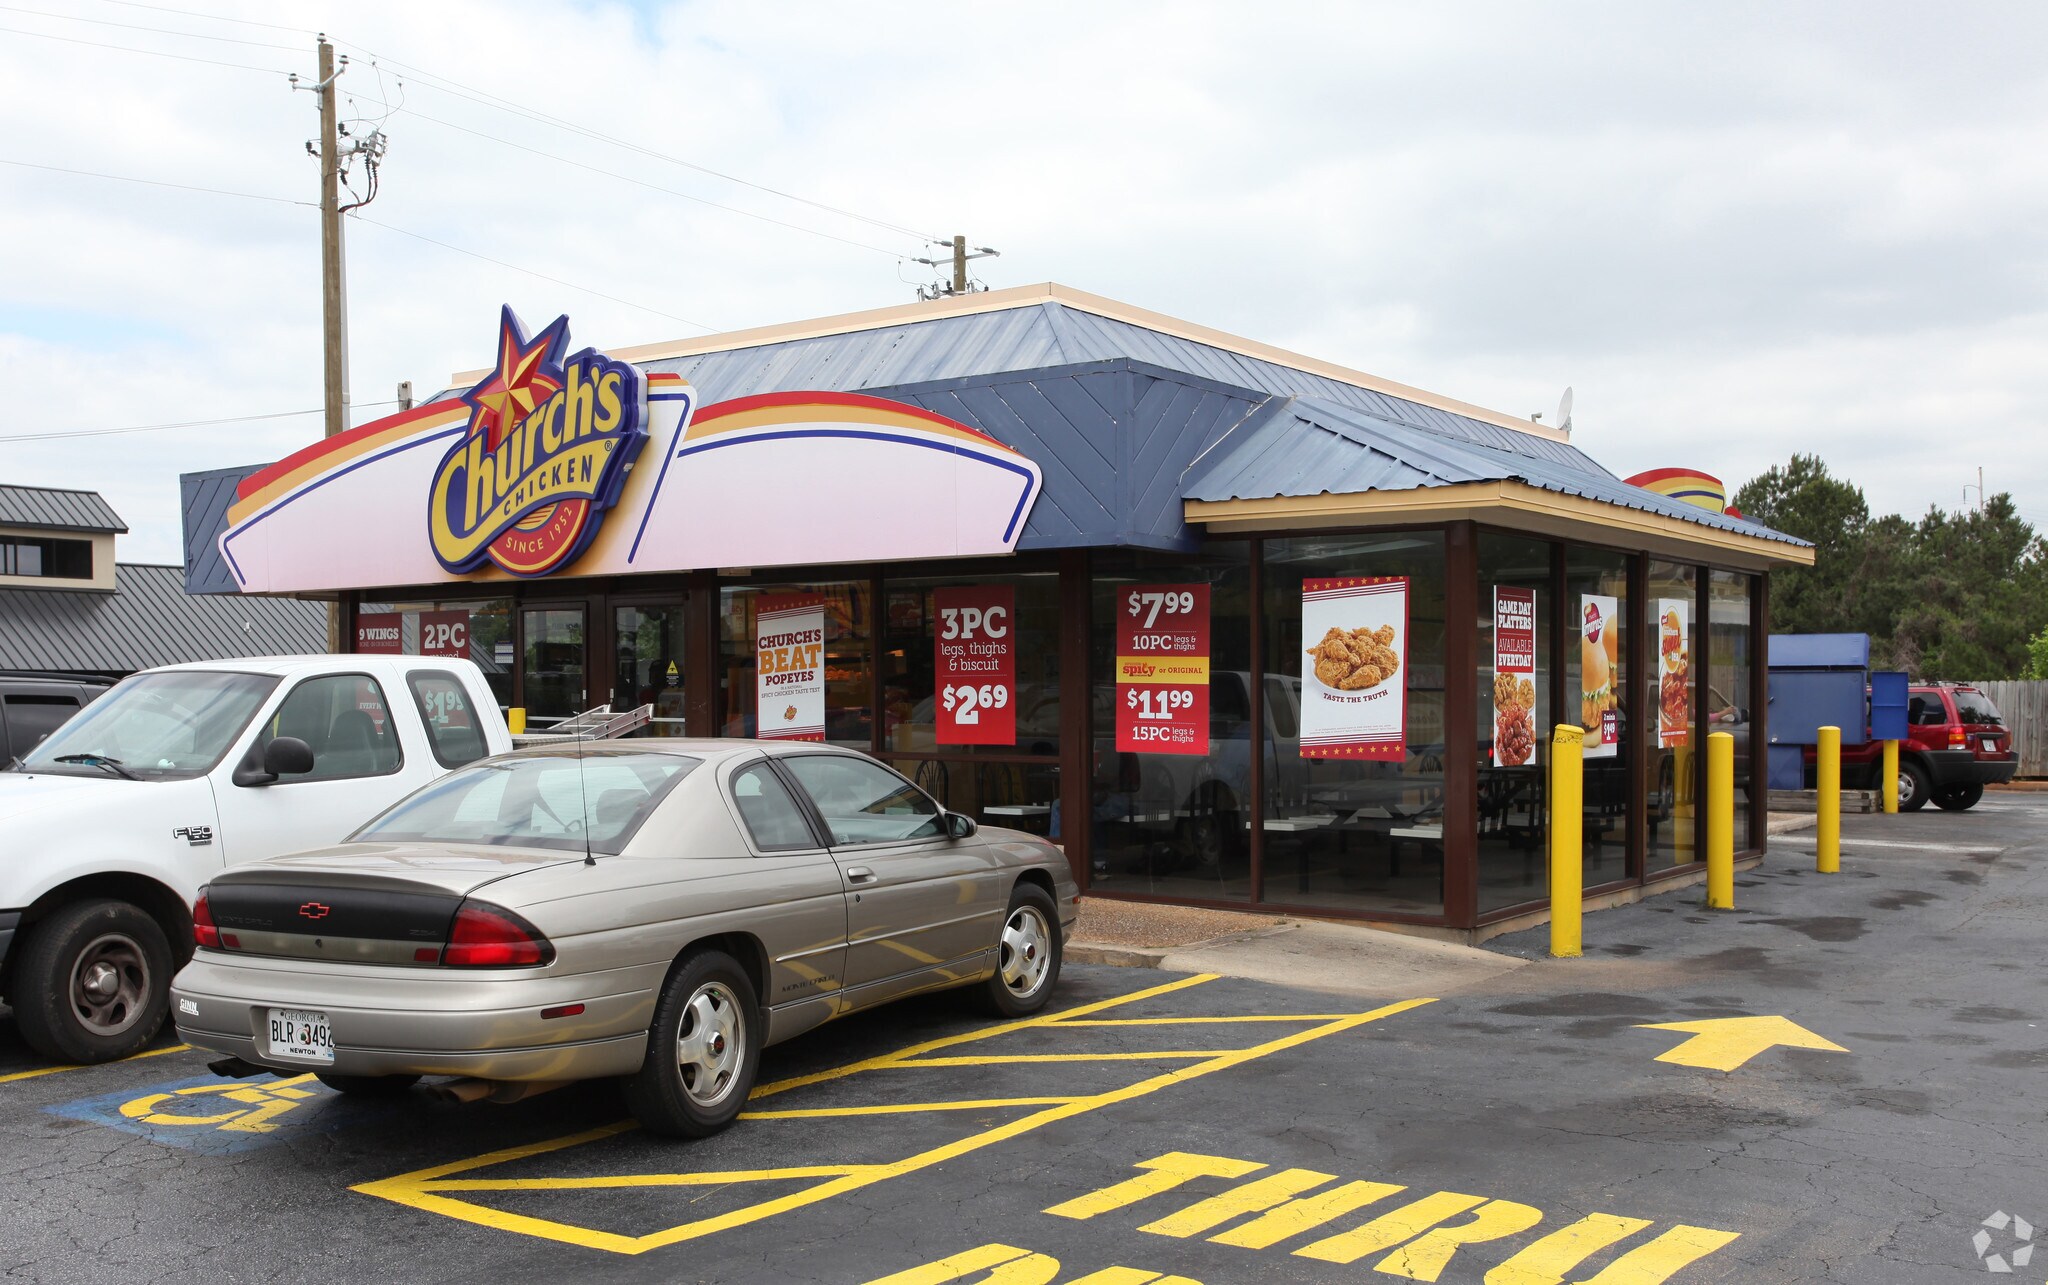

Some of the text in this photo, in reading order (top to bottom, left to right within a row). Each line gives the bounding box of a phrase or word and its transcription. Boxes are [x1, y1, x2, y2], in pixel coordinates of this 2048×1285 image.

[431, 363, 622, 563] Church's
[504, 454, 594, 516] CHICKEN
[505, 506, 573, 554] SINCE 1952
[1497, 600, 1532, 615] GAME DAY
[941, 606, 1007, 640] 3PC
[1497, 615, 1532, 631] PLATTERS
[359, 627, 399, 640] 9 WINGS
[424, 622, 466, 649] 2PC
[758, 629, 822, 650] CHURCH'S
[941, 641, 1007, 658] legs, thighs
[1132, 635, 1172, 650] 10PC
[1174, 635, 1189, 644] legs
[1173, 642, 1196, 651] thighs
[1498, 638, 1532, 653] AVAILABLE
[758, 643, 822, 675] BEAT
[949, 658, 999, 671] & biscuit
[1498, 653, 1532, 667] EVERYDAY
[1123, 663, 1156, 677] spicy
[765, 670, 814, 686] POPEYES
[774, 689, 795, 697] CHICKEN
[795, 687, 809, 695] TASTE
[1323, 692, 1345, 703] TASTE
[1363, 689, 1389, 702] TRUTH
[1132, 726, 1170, 741] 15PC
[1172, 727, 1187, 736] legs
[1172, 734, 1194, 743] thighs
[180, 998, 198, 1011] GINN
[284, 1012, 322, 1024] GEORGIA
[272, 1020, 294, 1044] BLR
[289, 1047, 316, 1055] NEWTON
[1040, 1151, 1744, 1285] THRU
